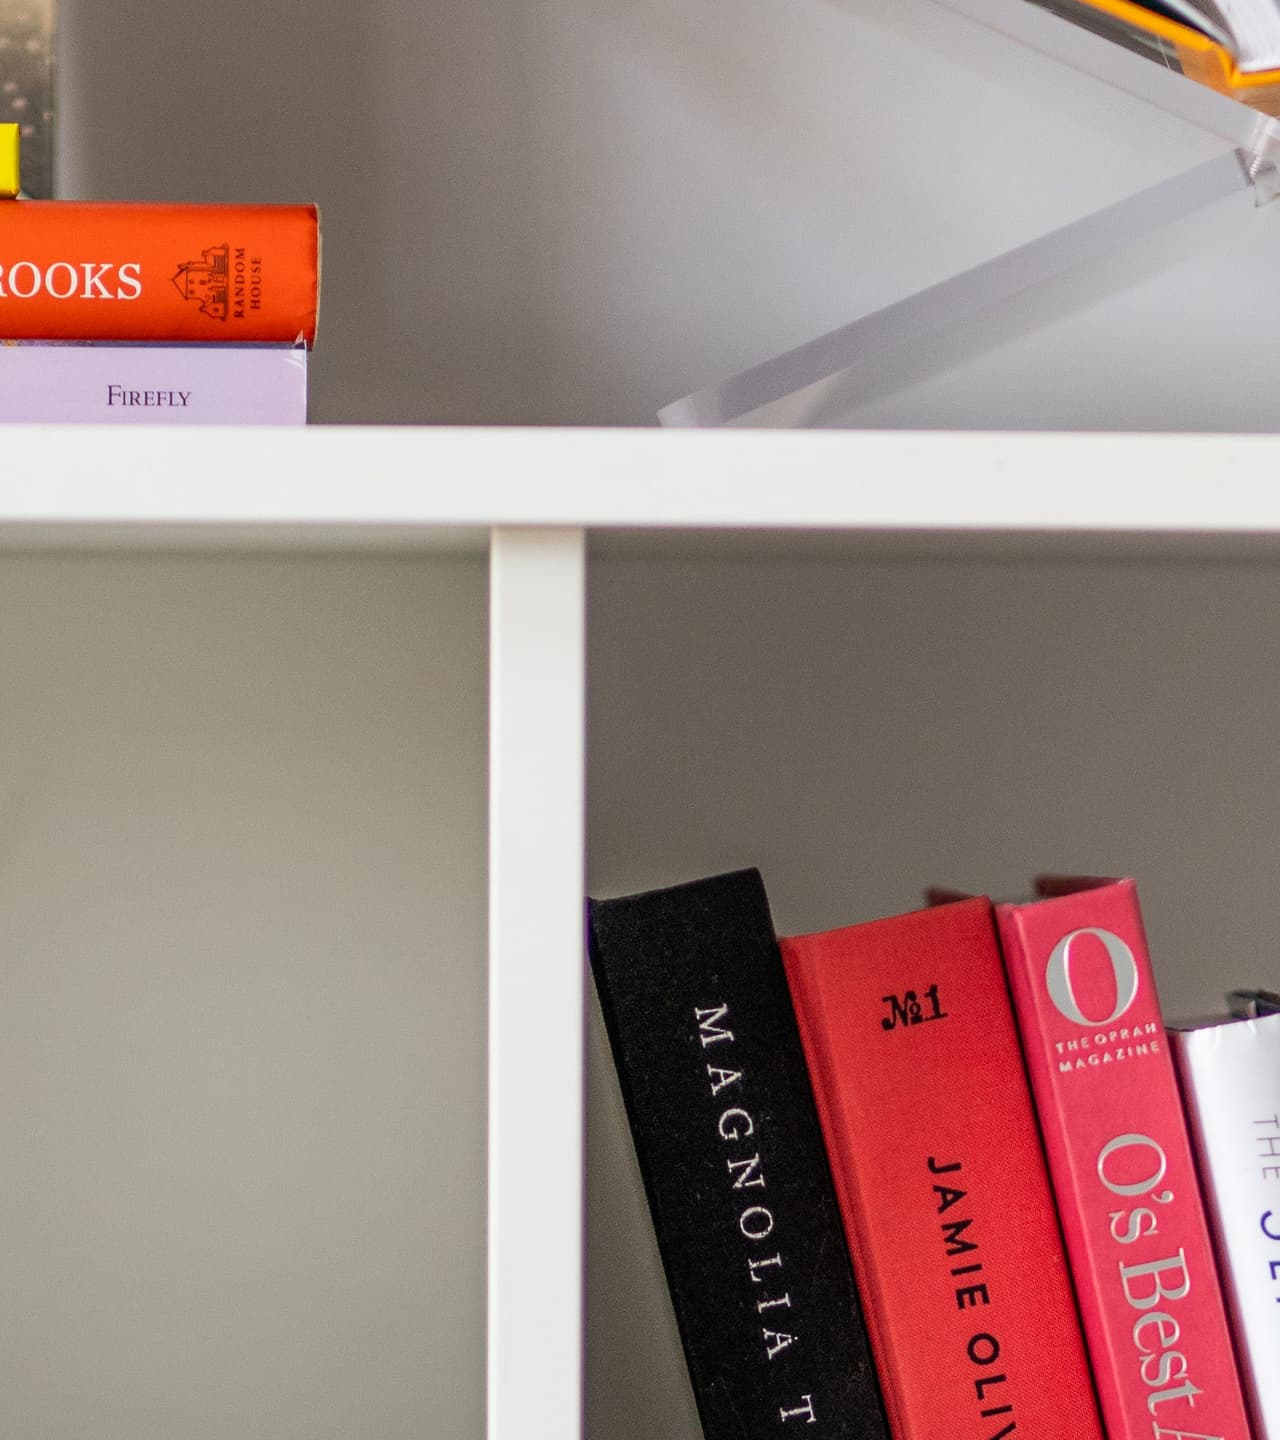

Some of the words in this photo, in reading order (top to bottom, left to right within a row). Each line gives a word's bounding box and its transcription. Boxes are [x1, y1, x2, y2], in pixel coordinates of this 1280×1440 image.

[107, 385, 191, 407] FIREFLY
[1046, 926, 1138, 1026] O
[695, 1003, 799, 1360] MAGNOLIA
[927, 1156, 989, 1310] JAMIE
[1097, 1133, 1173, 1245] O's
[1119, 1247, 1202, 1424] Best
